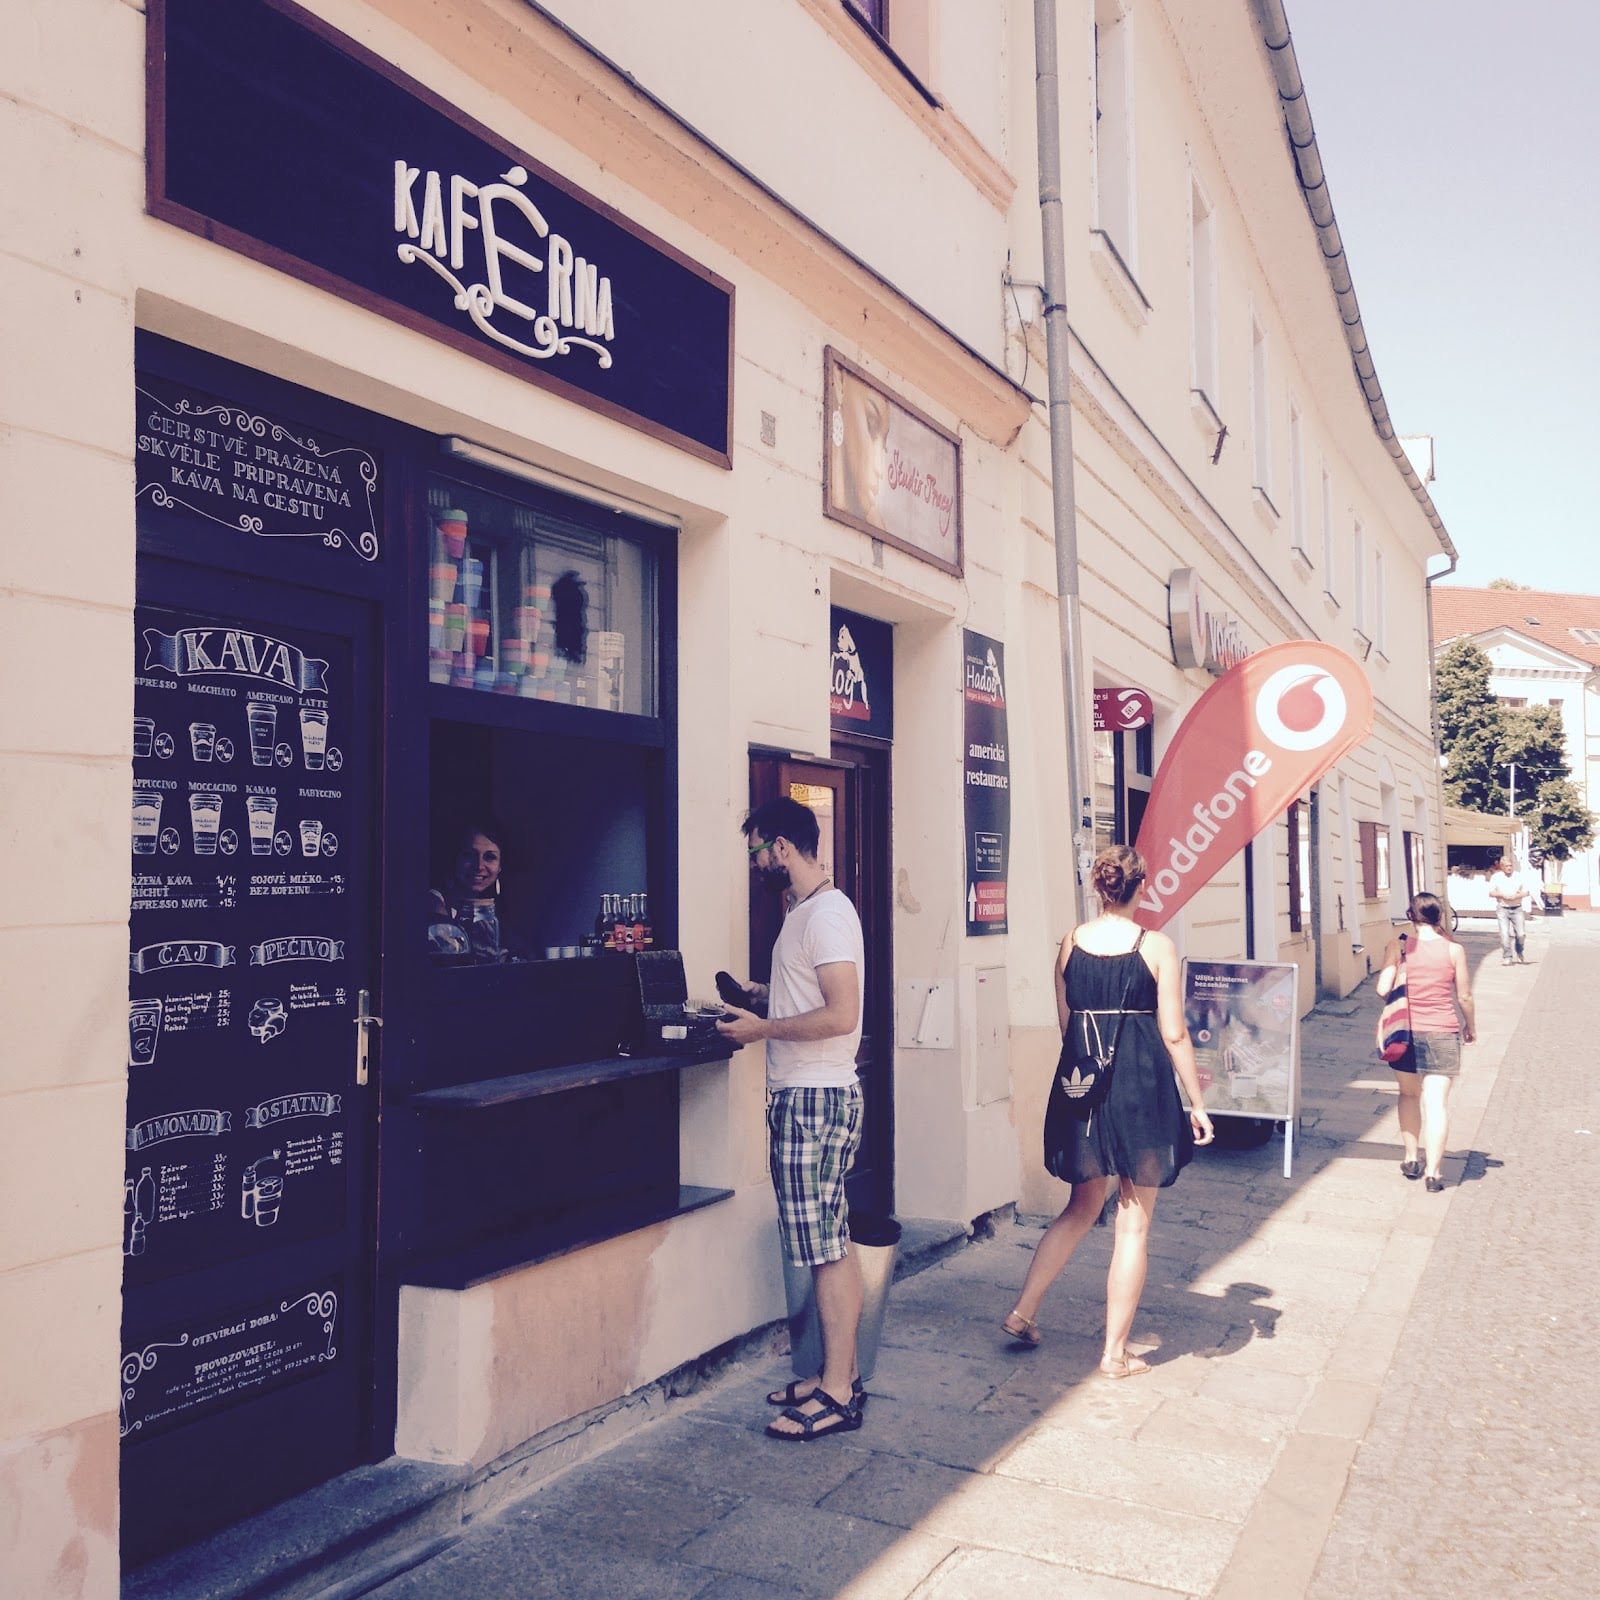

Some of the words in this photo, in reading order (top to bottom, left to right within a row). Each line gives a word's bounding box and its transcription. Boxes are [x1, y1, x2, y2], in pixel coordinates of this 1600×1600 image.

[394, 159, 615, 342] KAFÉRNA
[138, 435, 221, 471] SKVĚLE
[234, 461, 351, 507] PŘIPRAVENÁ
[255, 445, 342, 484] PRAŽENÁ
[171, 466, 224, 495] KÁVA
[232, 483, 259, 504] NA
[264, 492, 325, 520] CESTU
[183, 631, 295, 686] KÁVA
[187, 683, 236, 697] MACCHIATO
[967, 664, 997, 703] Hadog
[246, 691, 293, 704] AMERICANO
[299, 698, 329, 708] LATTE
[969, 743, 1005, 762] americká
[188, 781, 237, 792] MOCCACINO
[245, 785, 276, 794] KAKAO
[966, 770, 1008, 789] restaurace
[299, 788, 342, 798] BABYCCINO
[1138, 750, 1272, 913] vodafone
[167, 873, 193, 885] KÁVA
[289, 871, 322, 884] MLÉKO
[249, 886, 269, 895] BEZ
[158, 944, 209, 965] ČAJ
[265, 937, 330, 961] PEČIVO
[132, 1014, 157, 1028] TEA
[258, 1096, 330, 1122] OSTATNÍ
[137, 1112, 219, 1145] LIMONÁDY
[192, 1318, 246, 1347] OTEVÍRACÍ
[194, 1341, 276, 1375] PROVOZOVATEL:
